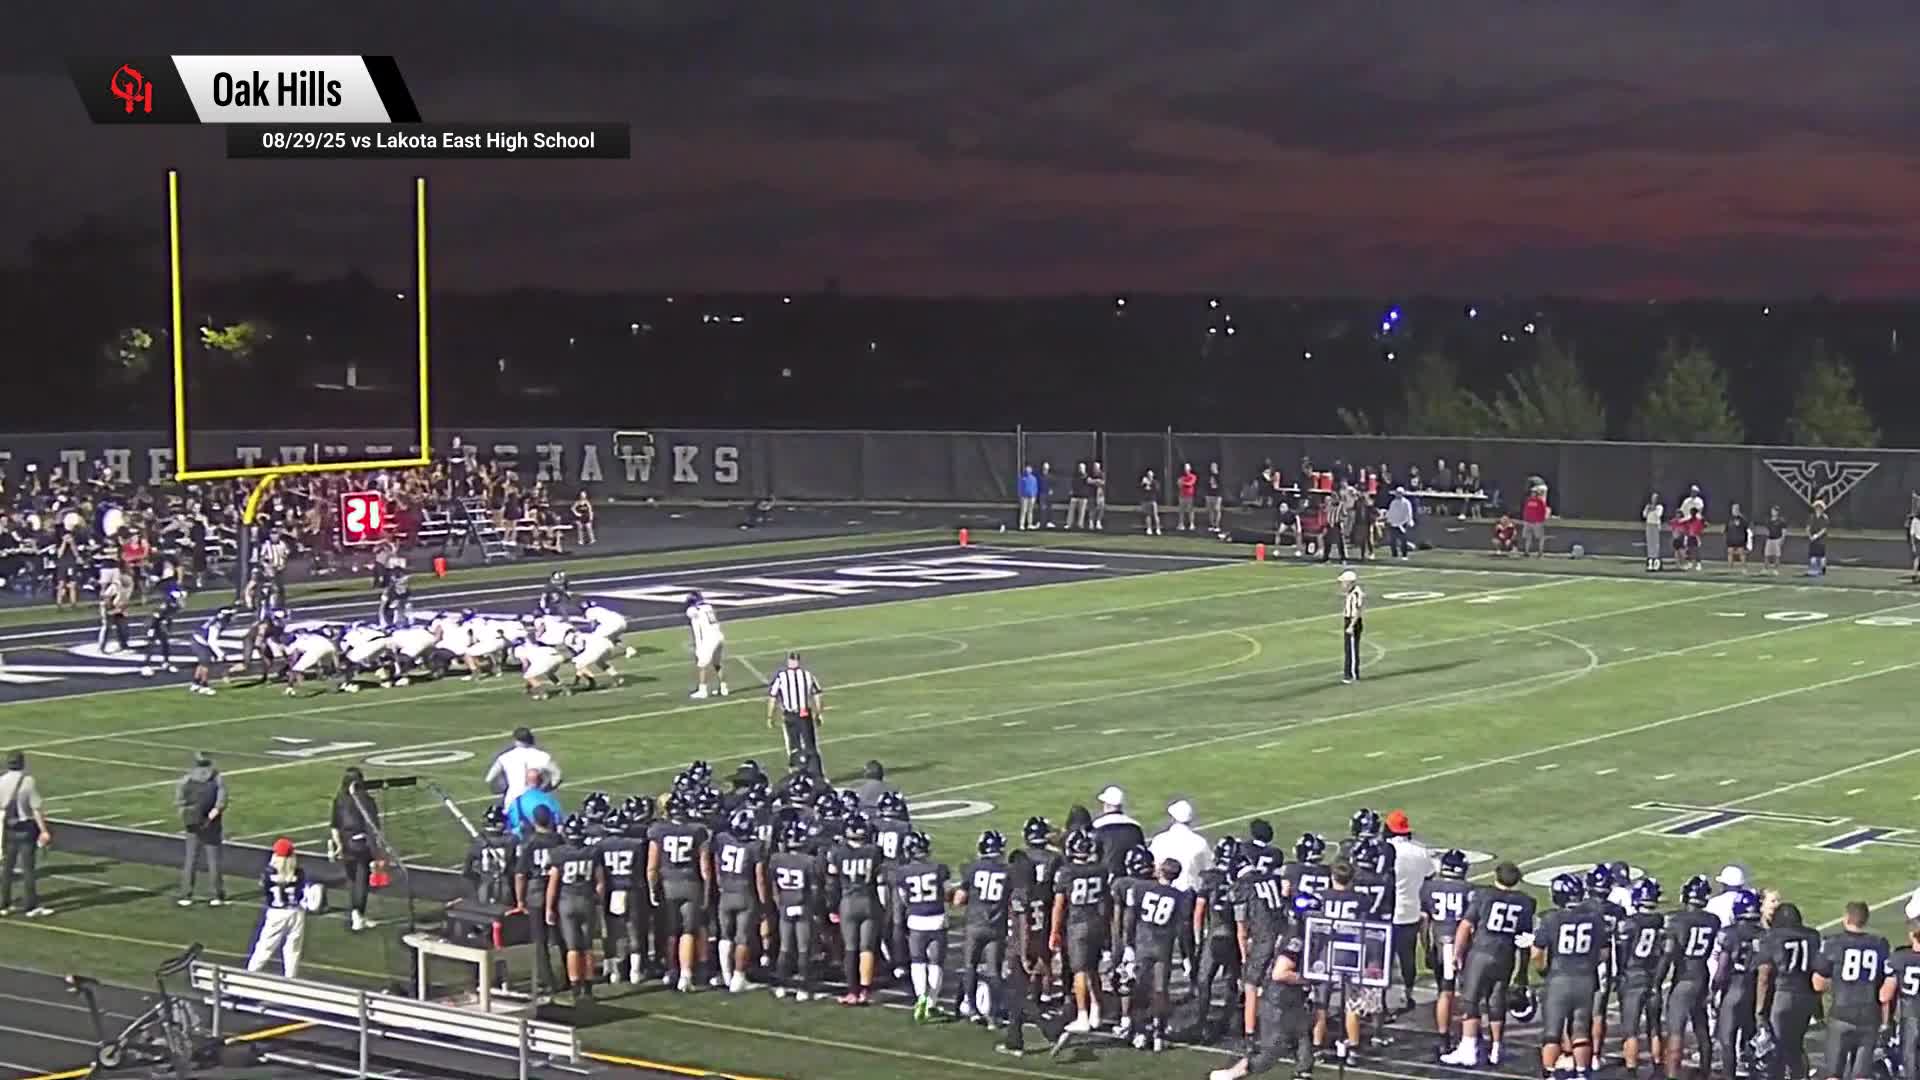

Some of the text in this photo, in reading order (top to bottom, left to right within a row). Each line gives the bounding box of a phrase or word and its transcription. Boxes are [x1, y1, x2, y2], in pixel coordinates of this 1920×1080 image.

[60, 444, 739, 486] THE THHAWKS
[347, 498, 381, 533] 21
[576, 555, 1106, 607] EAST
[603, 851, 634, 876] 42
[663, 835, 694, 864] 92
[720, 845, 745, 874] 51
[563, 860, 593, 884] 84
[776, 867, 805, 890] 23
[842, 859, 873, 884] 44
[974, 870, 1007, 901] 96
[904, 873, 938, 902] 35
[1071, 877, 1102, 905] 82
[1255, 880, 1282, 909] 41
[1141, 891, 1176, 925] 58
[1431, 892, 1464, 922] 34
[1486, 901, 1522, 933] 65
[1558, 922, 1593, 955] 66
[1635, 928, 1656, 958] 8
[1684, 926, 1713, 957] 15
[1784, 939, 1808, 972] 71
[1841, 948, 1879, 982] 89
